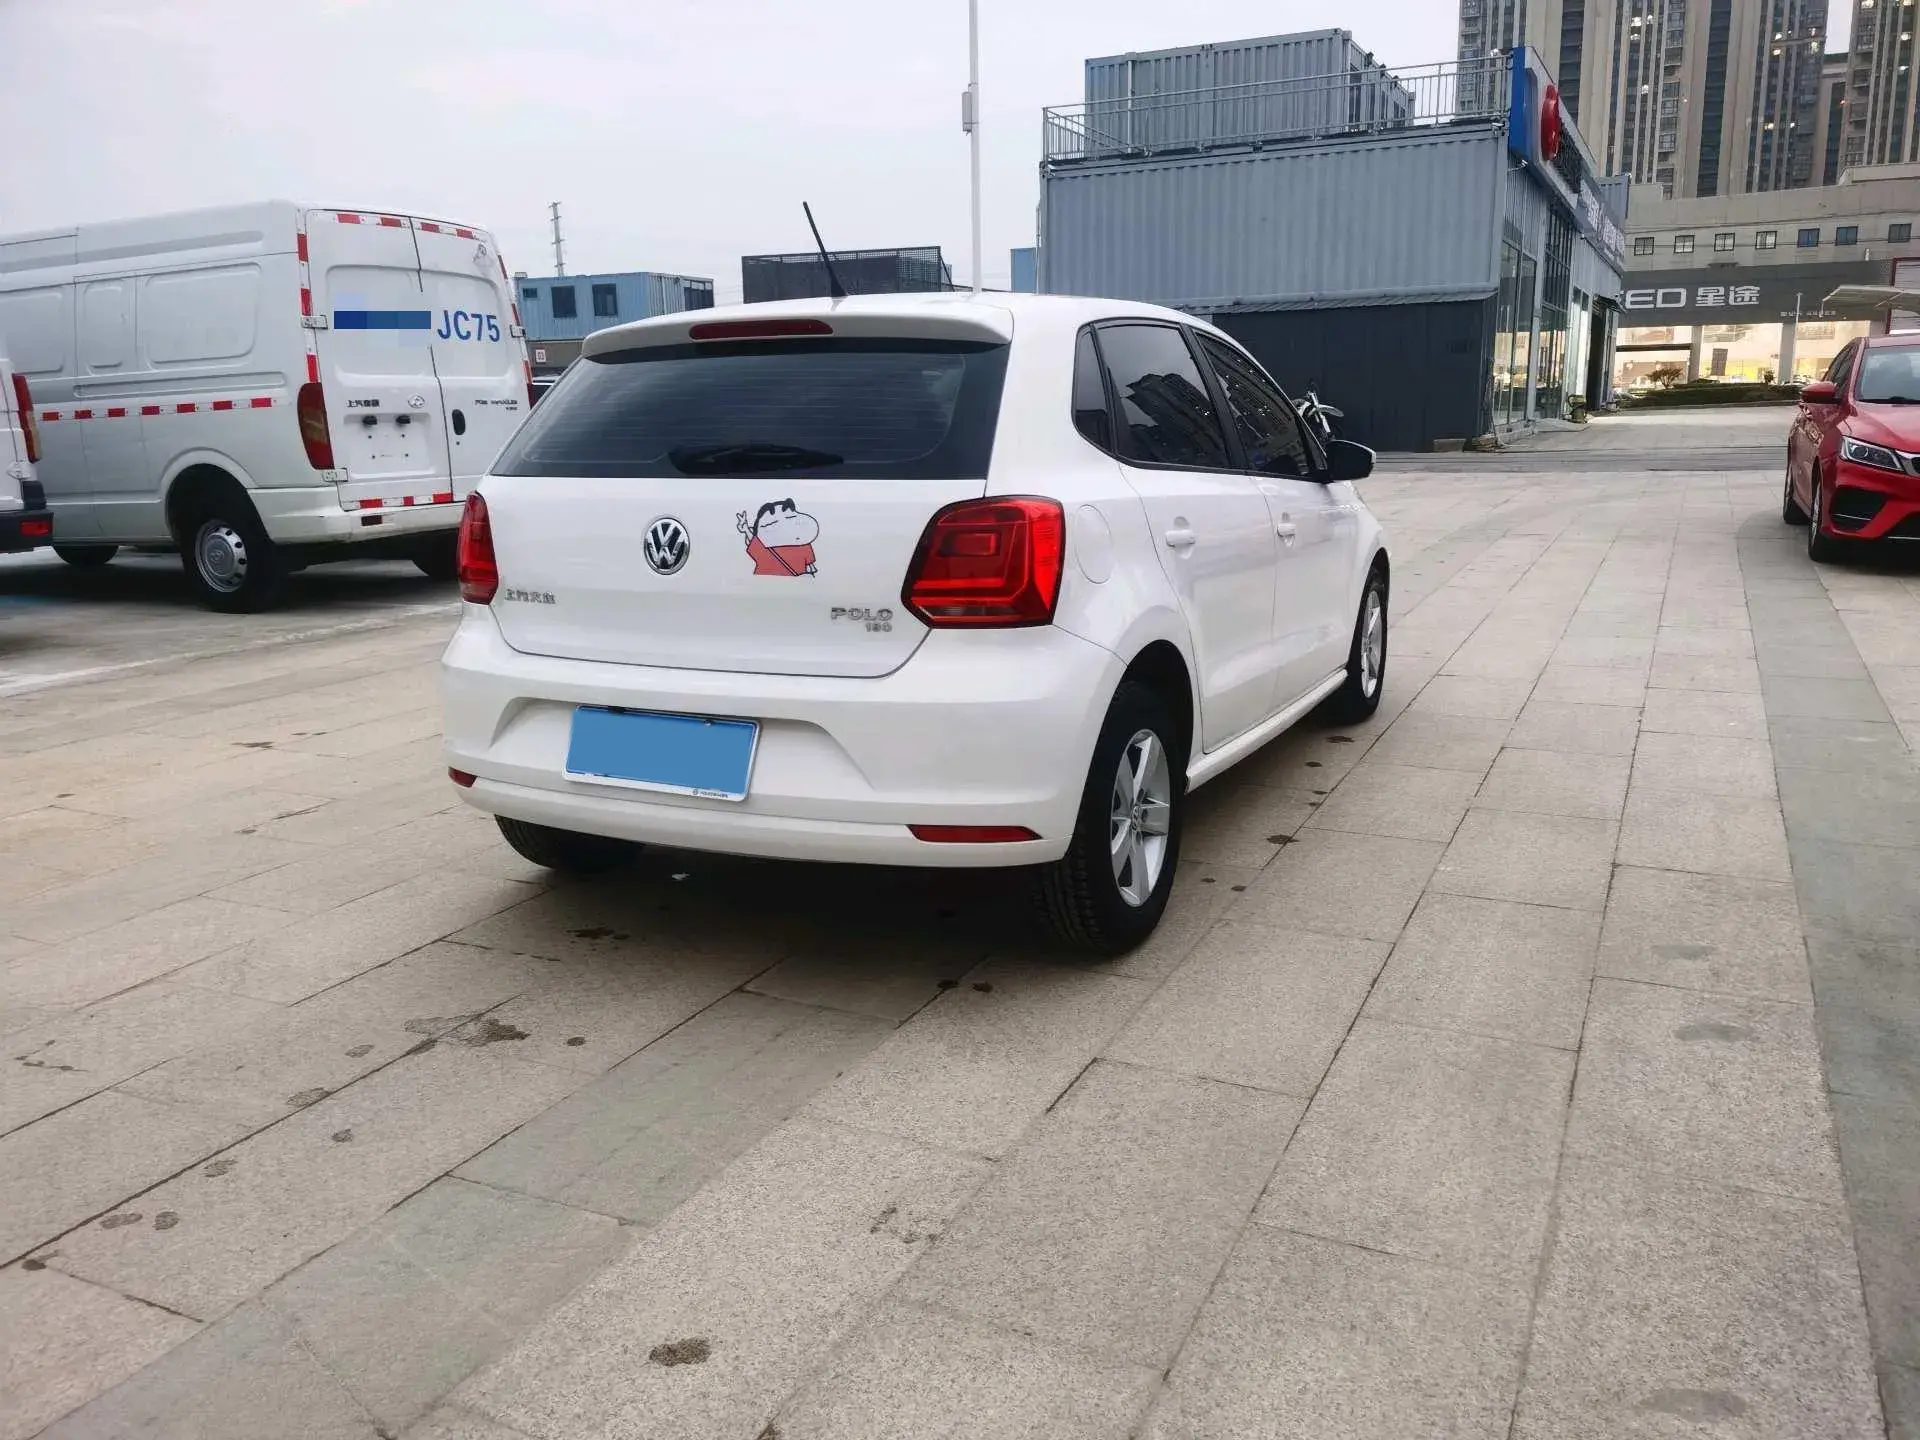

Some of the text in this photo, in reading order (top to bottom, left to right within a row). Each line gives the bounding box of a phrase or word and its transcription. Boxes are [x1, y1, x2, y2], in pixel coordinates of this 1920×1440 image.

[1695, 285, 1761, 307] 星途
[437, 309, 501, 342] JC75
[831, 607, 894, 622] POLO
